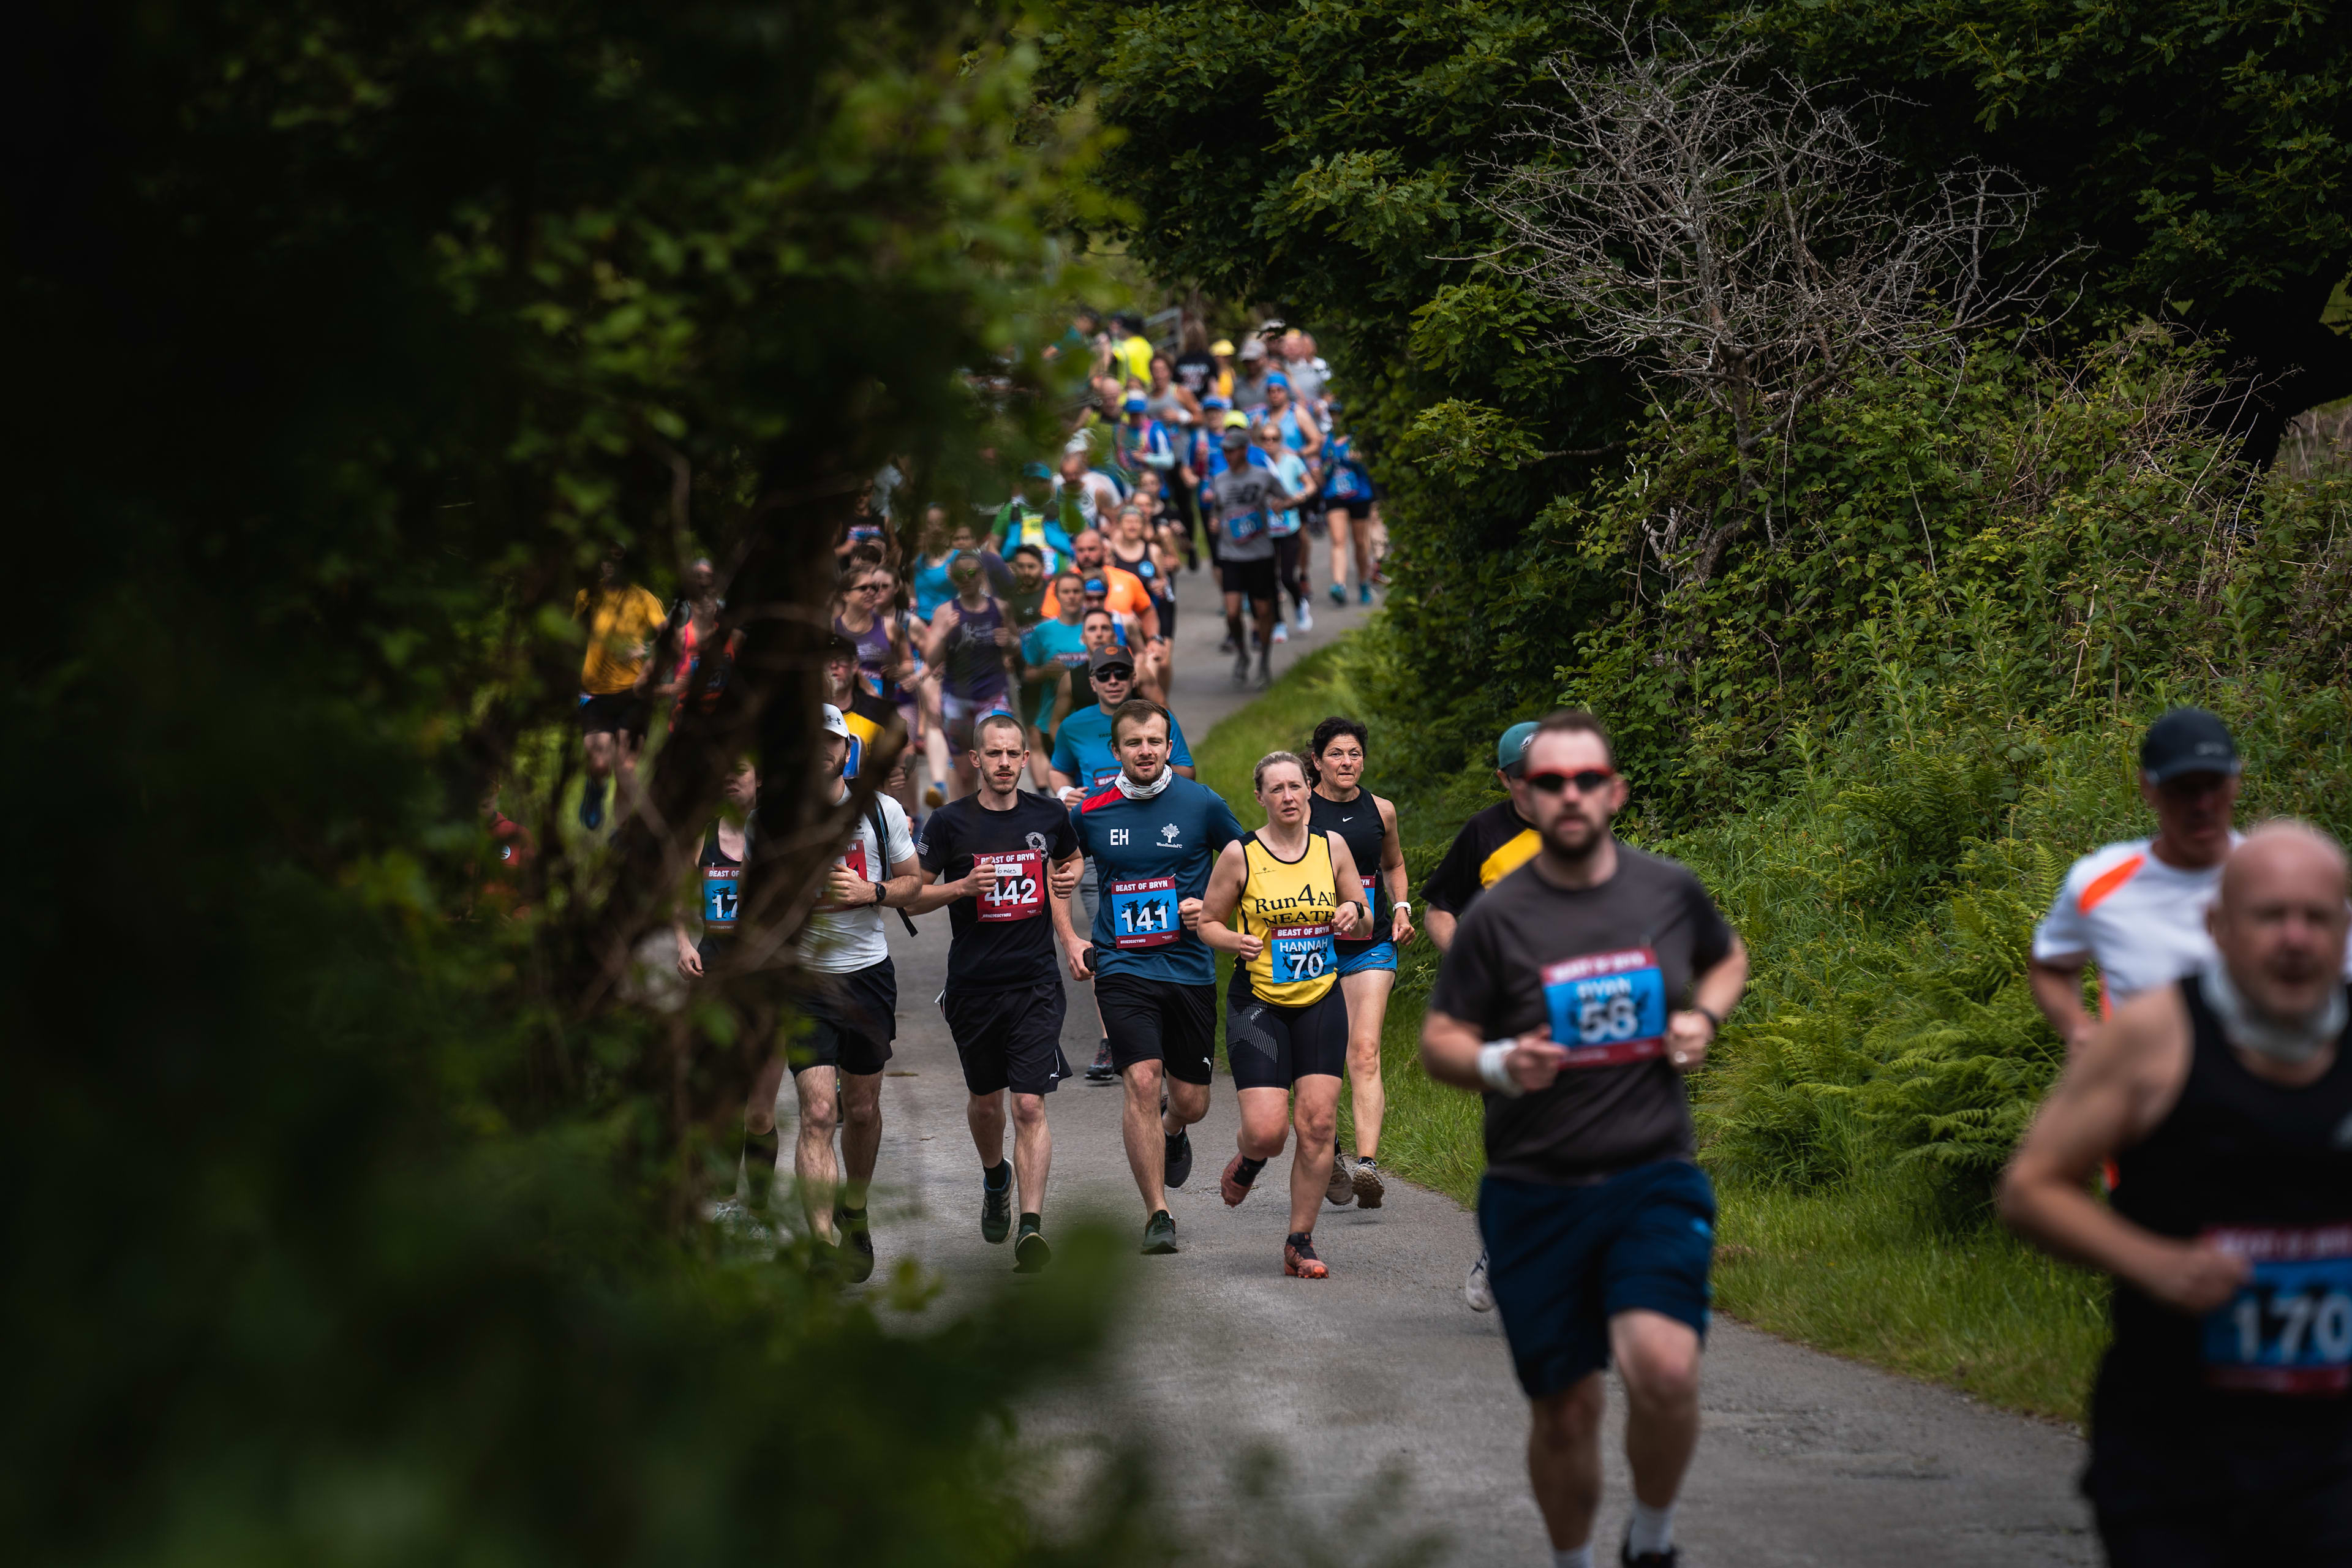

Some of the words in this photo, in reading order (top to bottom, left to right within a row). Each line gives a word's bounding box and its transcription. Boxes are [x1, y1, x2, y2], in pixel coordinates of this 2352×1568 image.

[1110, 829, 1129, 845] EH
[1017, 853, 1035, 862] BRYN
[984, 878, 1038, 907] 442
[1115, 882, 1136, 892] BEAST
[1149, 880, 1168, 889] BRYN
[712, 894, 738, 918] 17
[1121, 905, 1168, 932] 141
[1262, 910, 1335, 927] NEATH
[1314, 925, 1330, 934] BRYN
[1280, 938, 1328, 952] HANNAH
[1290, 952, 1324, 979] 70
[2234, 1292, 2352, 1364] 170
